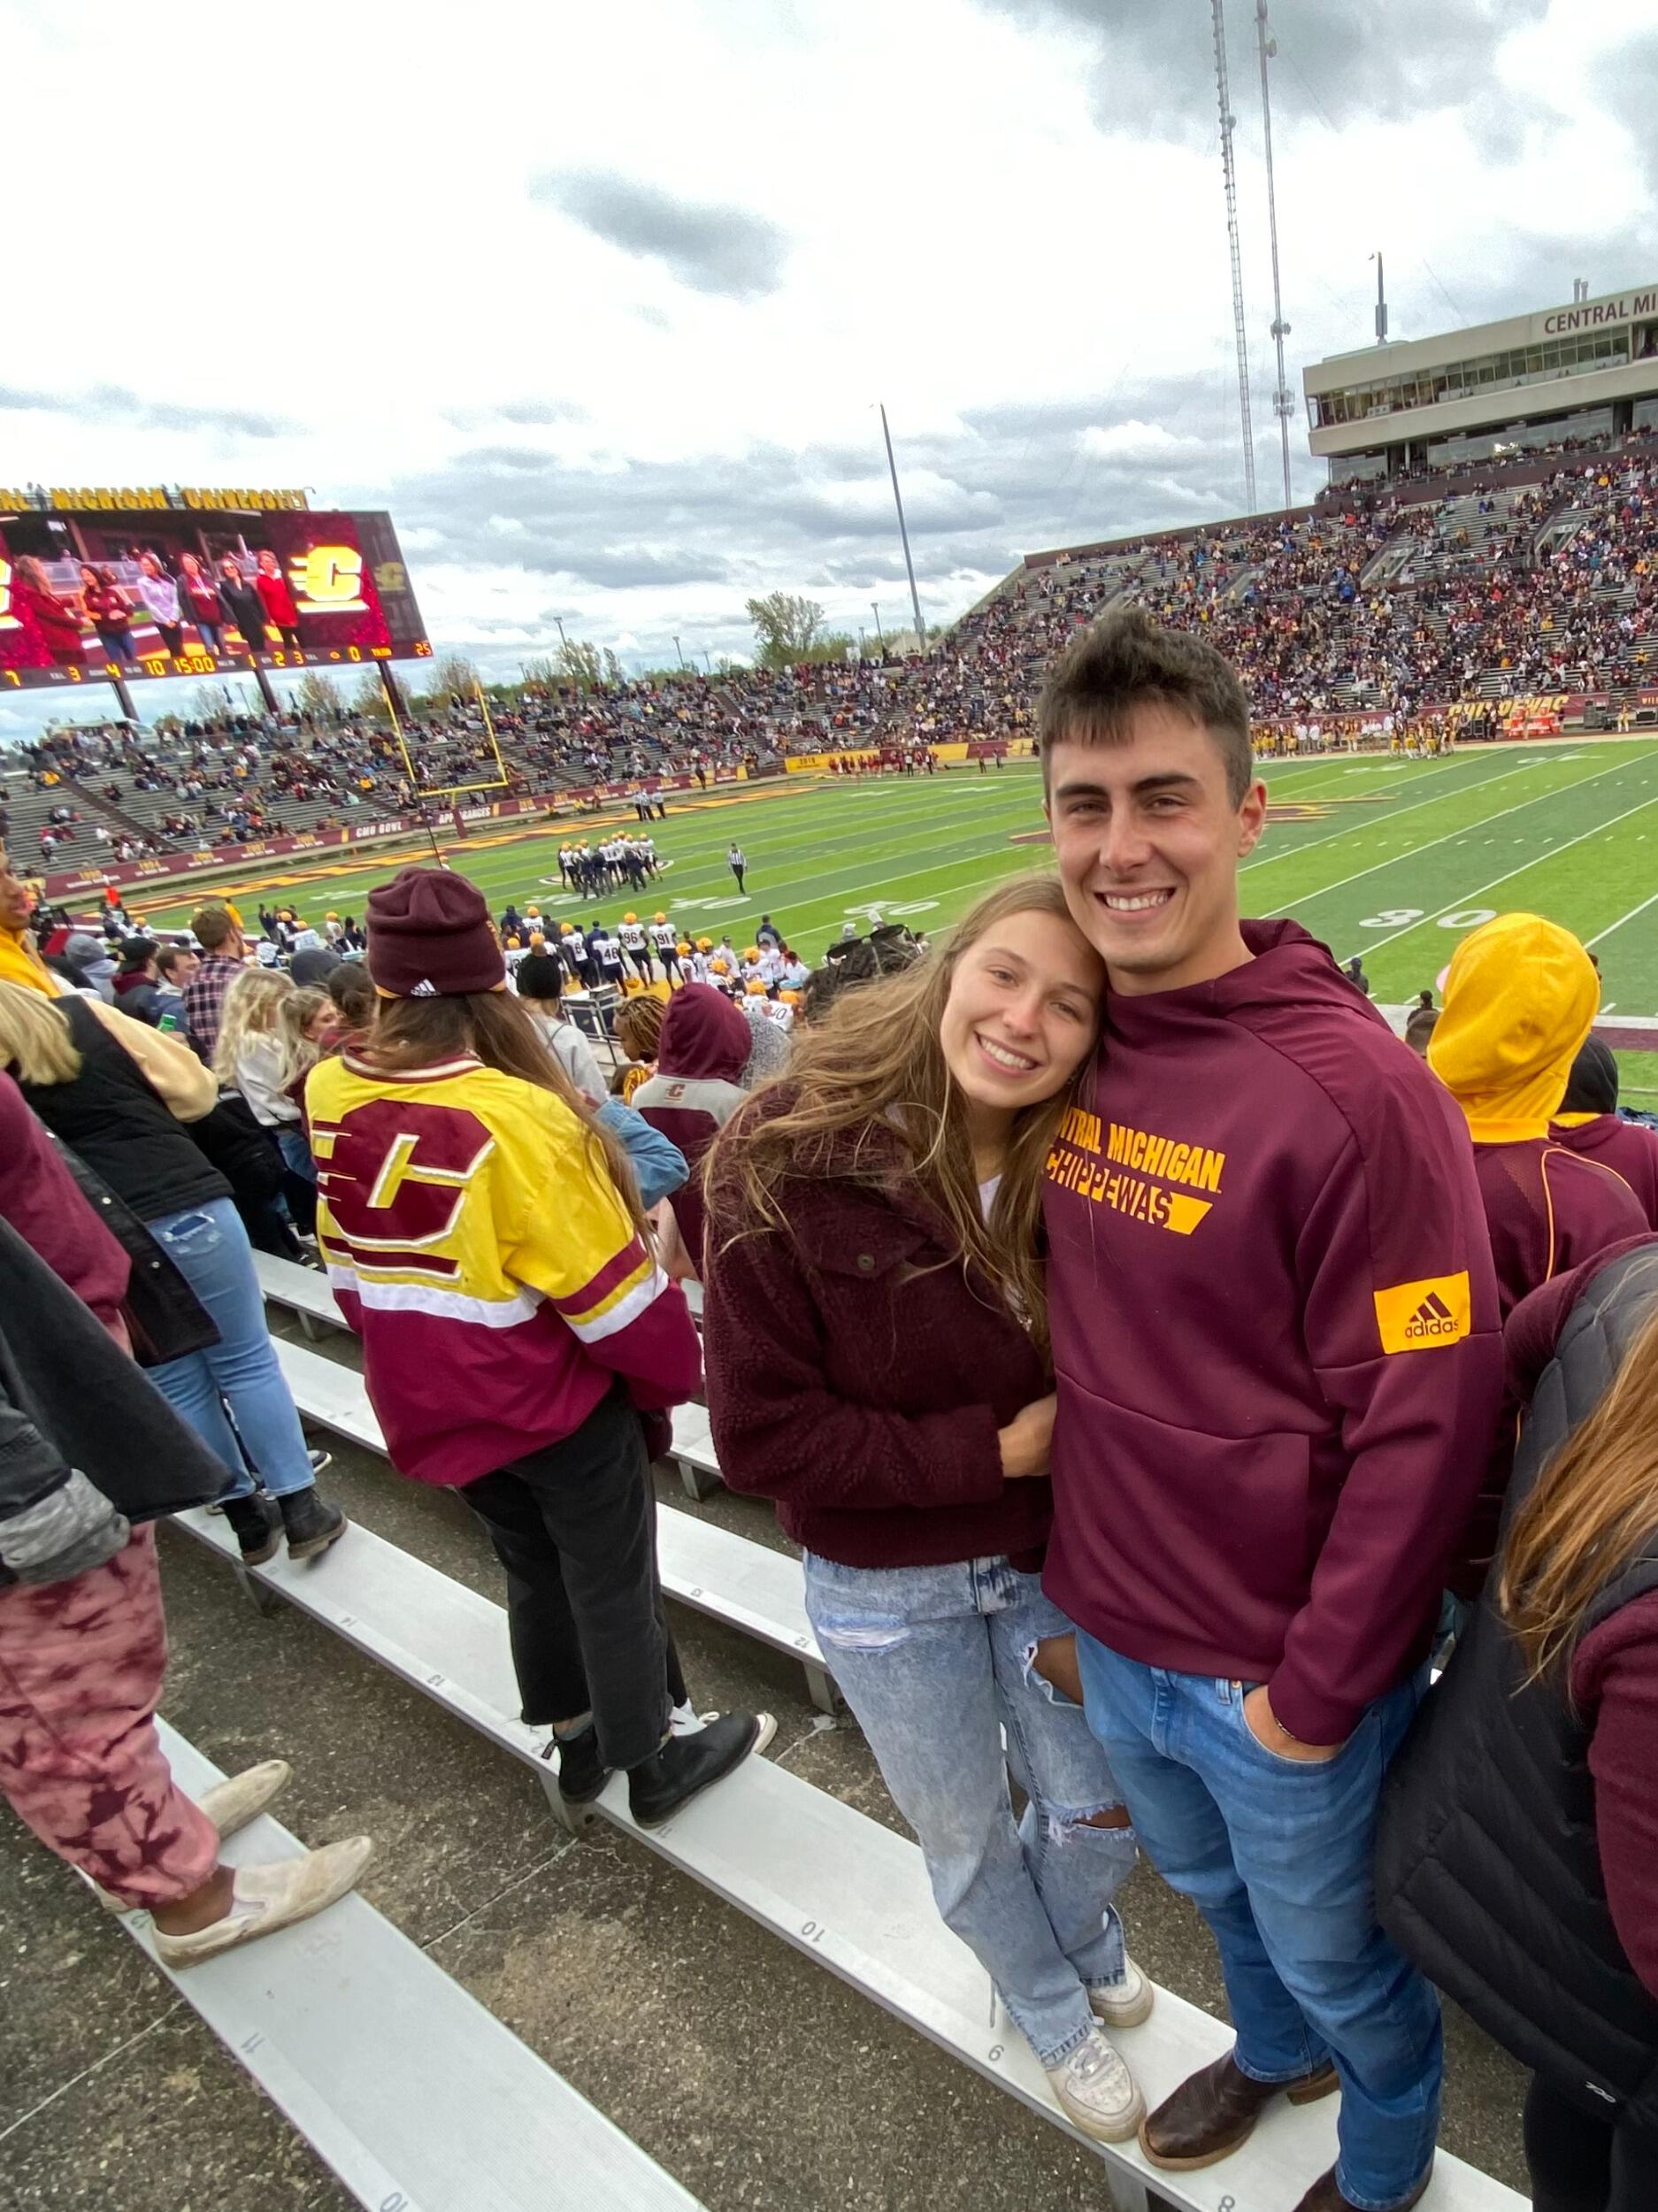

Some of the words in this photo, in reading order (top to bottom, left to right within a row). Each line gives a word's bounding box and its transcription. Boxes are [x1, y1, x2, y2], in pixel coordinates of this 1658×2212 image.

[1545, 300, 1629, 334] CENTRAL
[1633, 293, 1656, 316] MI
[50, 487, 171, 511] MICHIGAN
[180, 487, 306, 511] UNIVERSITY
[248, 654, 257, 668] 1
[273, 651, 286, 667] 2
[349, 646, 361, 662] 0
[106, 664, 121, 679] 4
[146, 660, 165, 676] 10
[175, 657, 216, 674] 15:00
[1360, 909, 1496, 928] 30
[623, 932, 638, 944] 96
[657, 933, 670, 945] 91
[1108, 1123, 1226, 1194] MICHIGAN
[1044, 1149, 1172, 1228] CHIPPEWAS
[1405, 1319, 1459, 1338] adidas
[802, 1920, 826, 1944] 10
